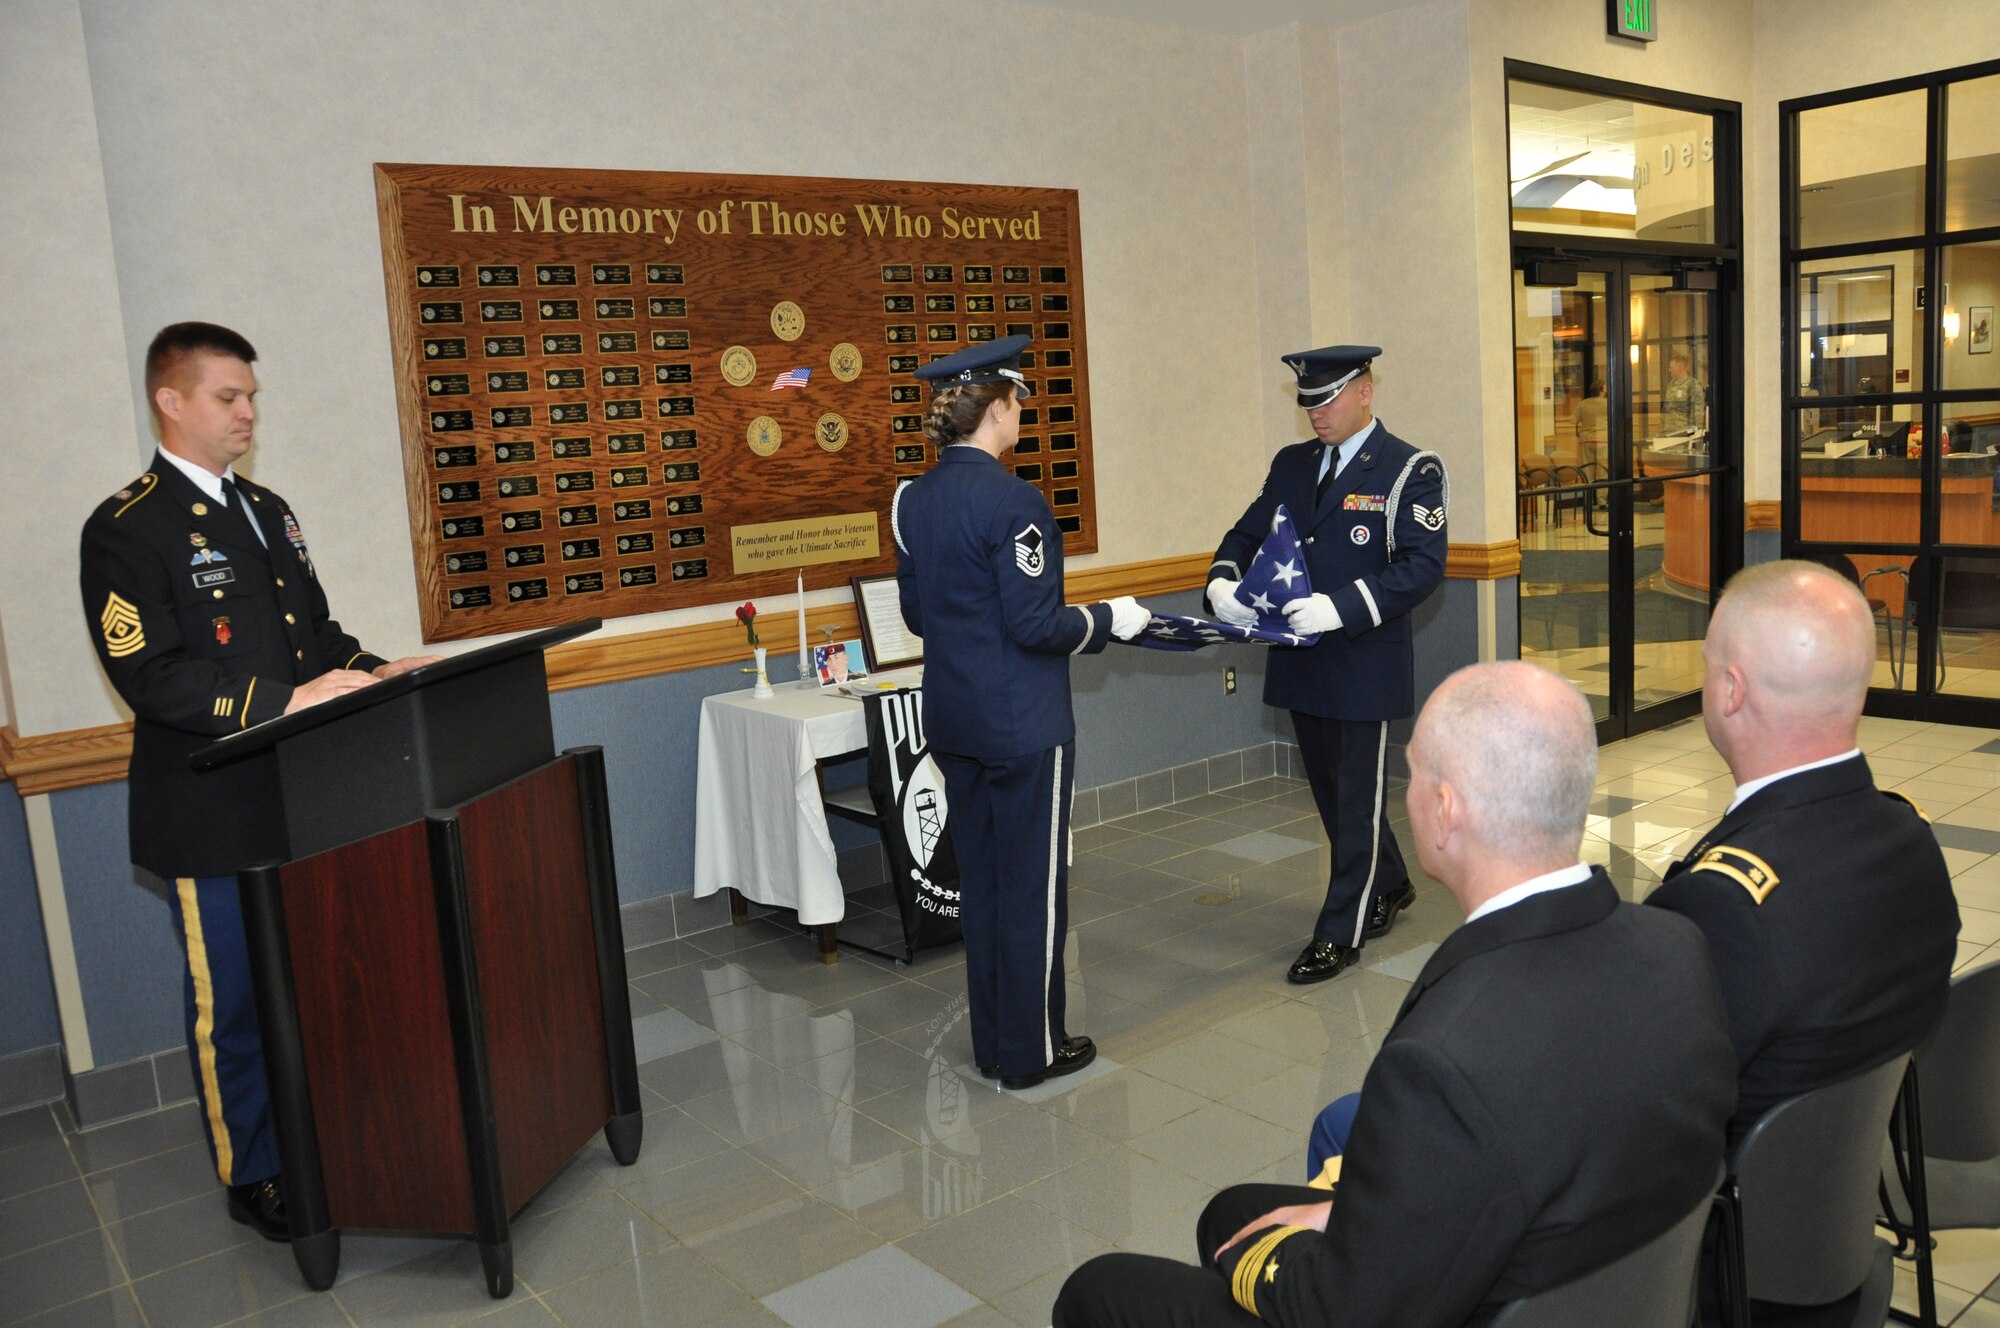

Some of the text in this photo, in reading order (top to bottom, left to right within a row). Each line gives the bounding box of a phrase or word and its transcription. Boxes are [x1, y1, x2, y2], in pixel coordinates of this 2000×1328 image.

[1663, 136, 1714, 176] Des
[448, 194, 1042, 245] In Memory of Those Who Served
[736, 524, 875, 546] Remember and Honor those Veterans
[748, 537, 866, 560] who gave the Ultimate Sacrifice
[879, 690, 927, 806] PO
[915, 892, 960, 917] YOU ARE
